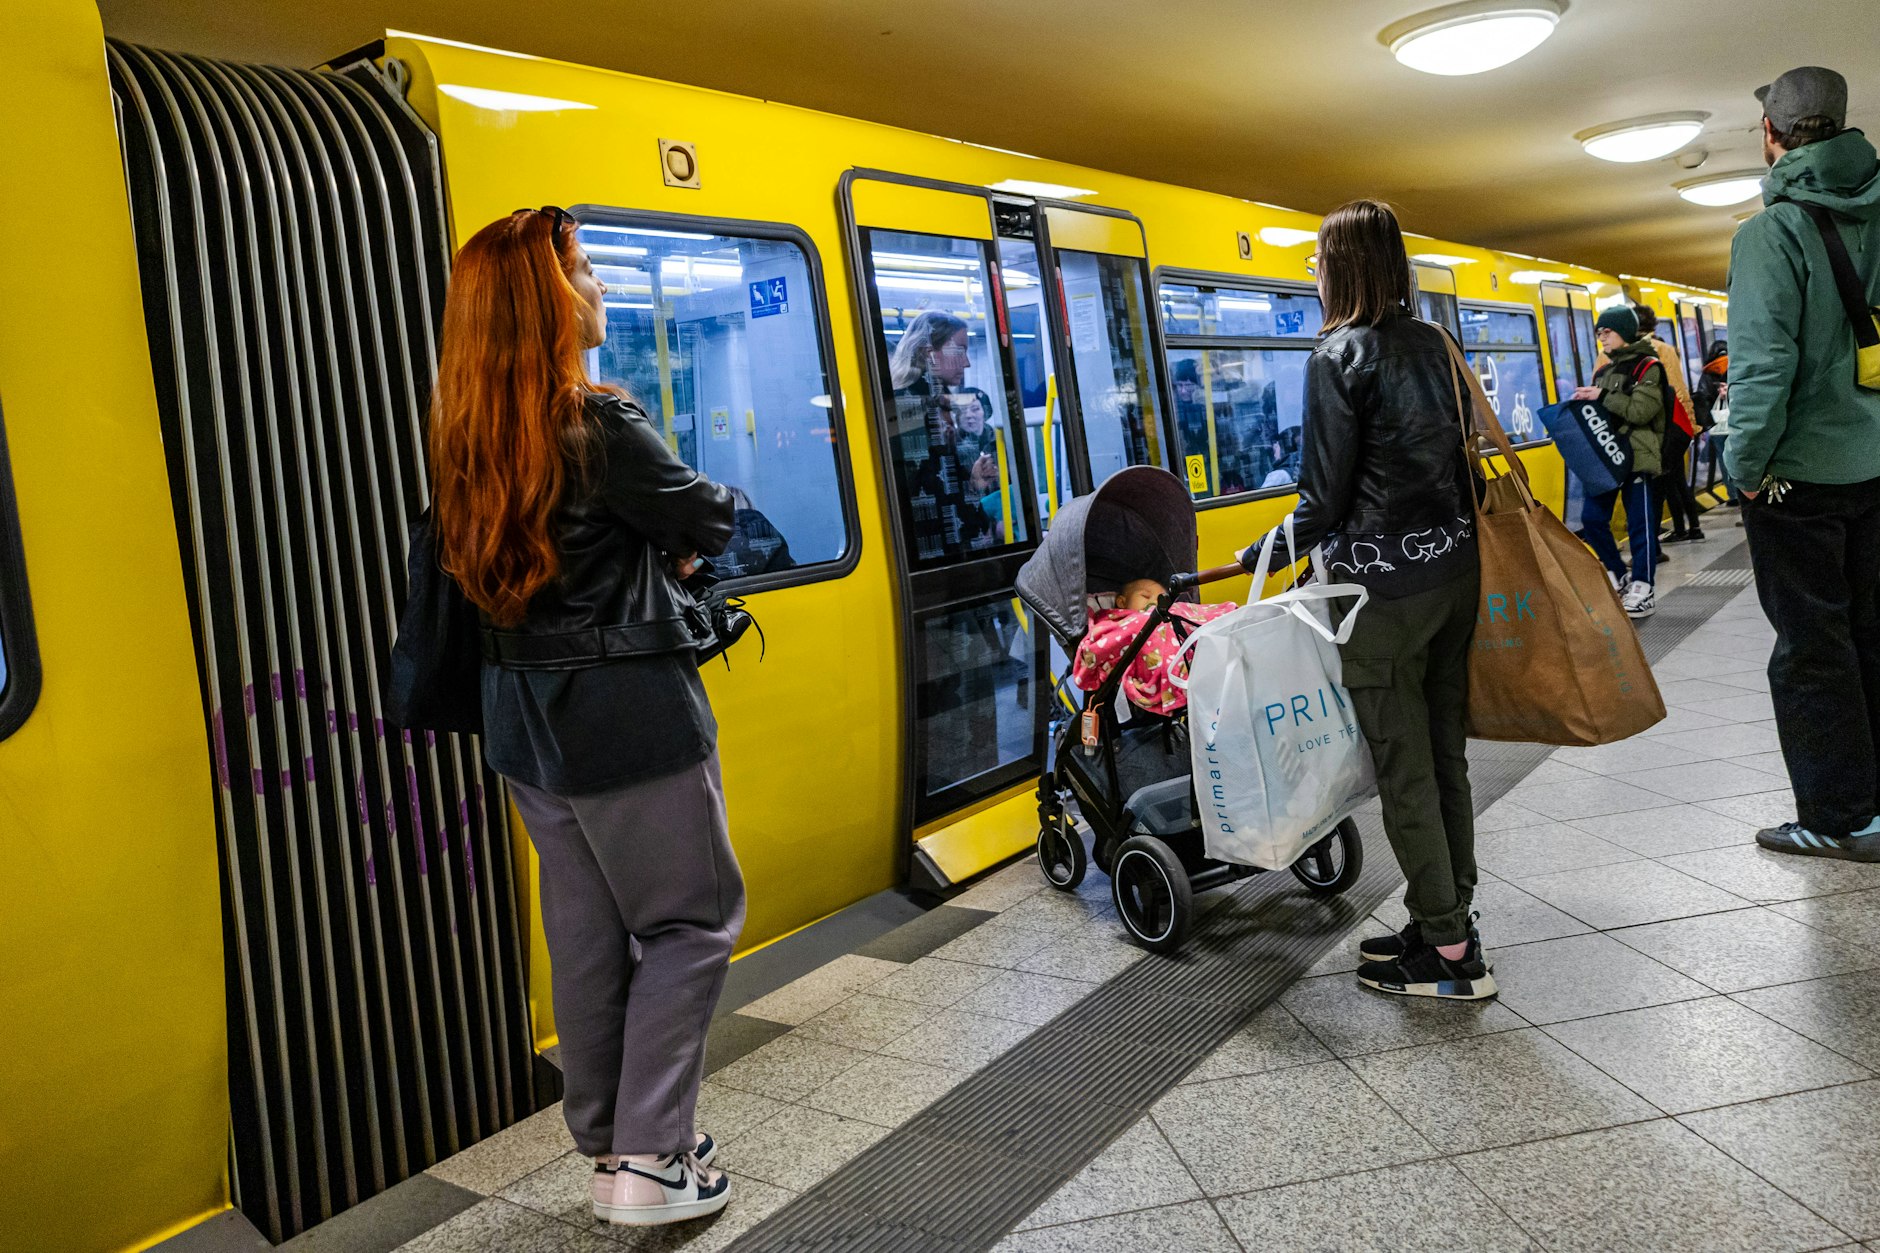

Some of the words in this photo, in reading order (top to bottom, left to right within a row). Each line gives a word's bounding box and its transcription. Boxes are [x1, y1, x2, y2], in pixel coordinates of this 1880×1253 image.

[1581, 404, 1626, 466] adidas
[1265, 681, 1346, 736] PRI
[1298, 733, 1332, 753] LOVE
